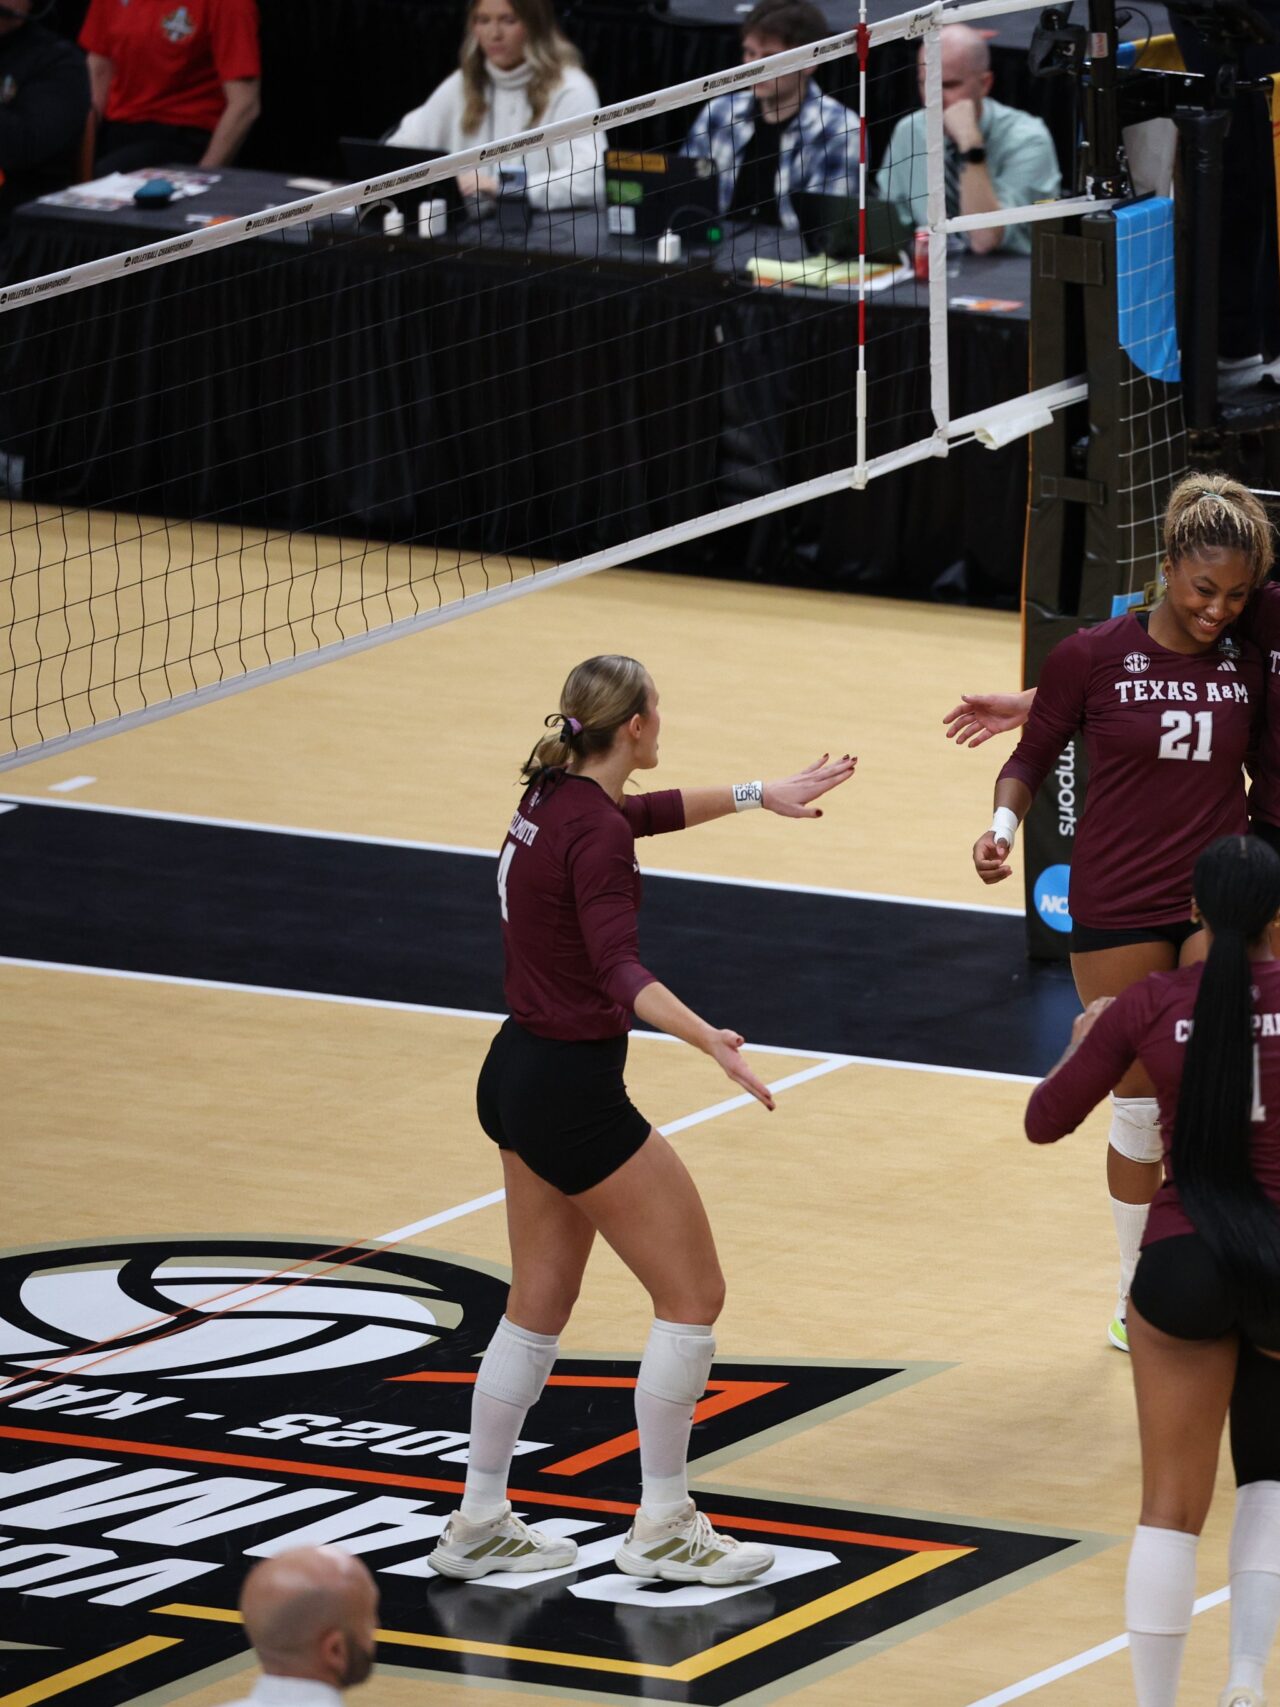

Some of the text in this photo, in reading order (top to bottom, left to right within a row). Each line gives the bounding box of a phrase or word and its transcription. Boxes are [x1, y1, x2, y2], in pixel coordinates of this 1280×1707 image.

[1125, 652, 1148, 671] SEC
[1115, 680, 1248, 703] TEXAS A&M
[1158, 710, 1213, 762] 21
[735, 788, 762, 801] LORD
[1040, 894, 1069, 914] NC
